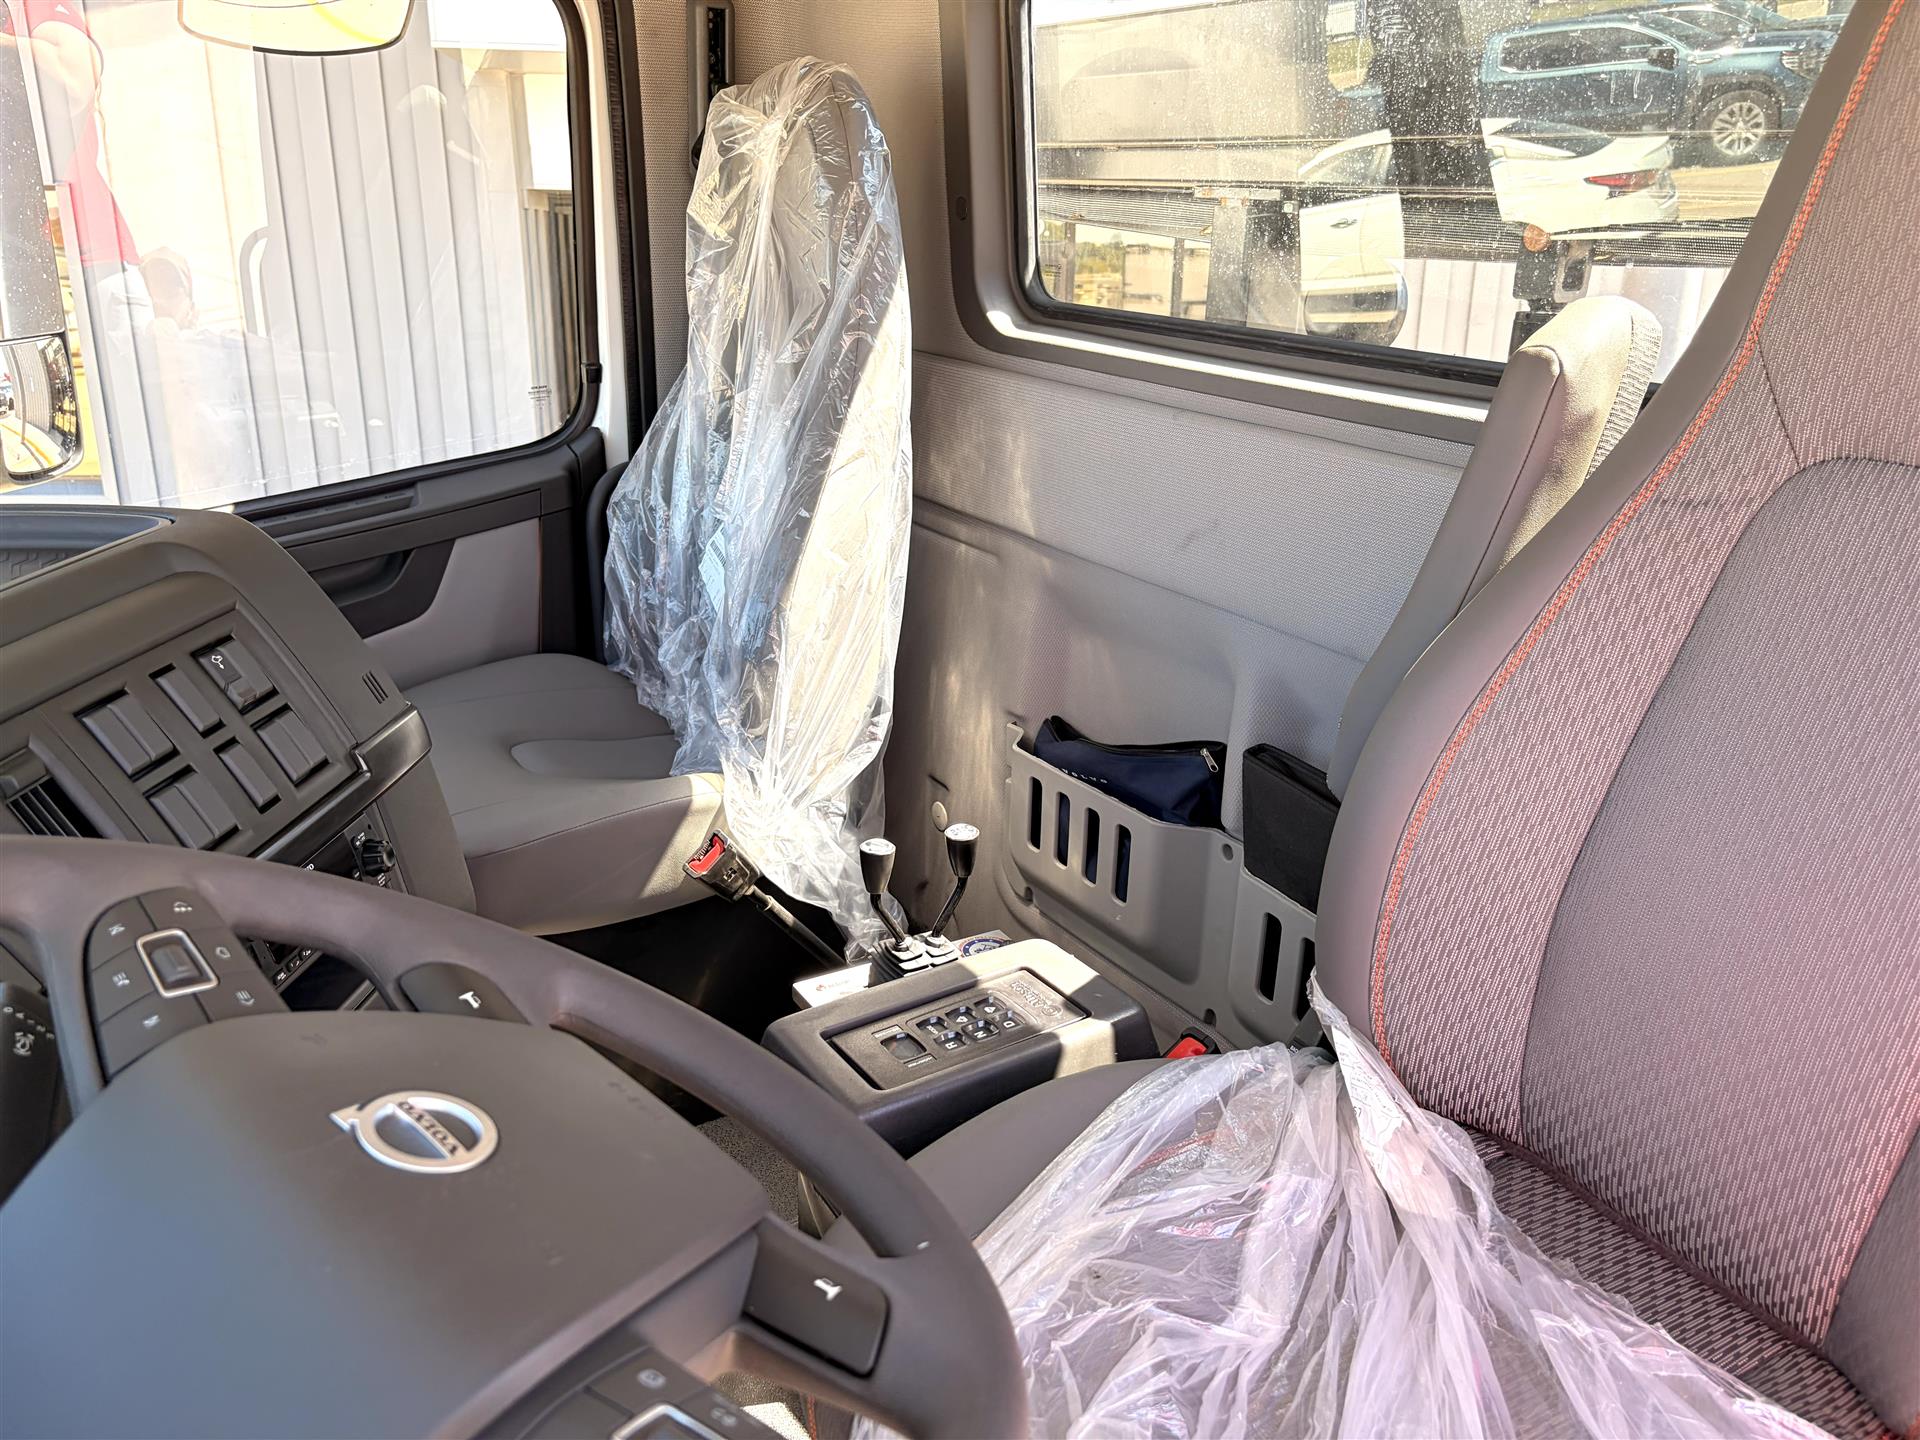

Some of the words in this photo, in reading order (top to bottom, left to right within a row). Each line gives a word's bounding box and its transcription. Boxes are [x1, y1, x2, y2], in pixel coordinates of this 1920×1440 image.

[1003, 1021, 1016, 1029] D
[974, 1030, 987, 1039] N
[945, 1041, 958, 1050] R
[398, 1102, 458, 1155] VOLVO
